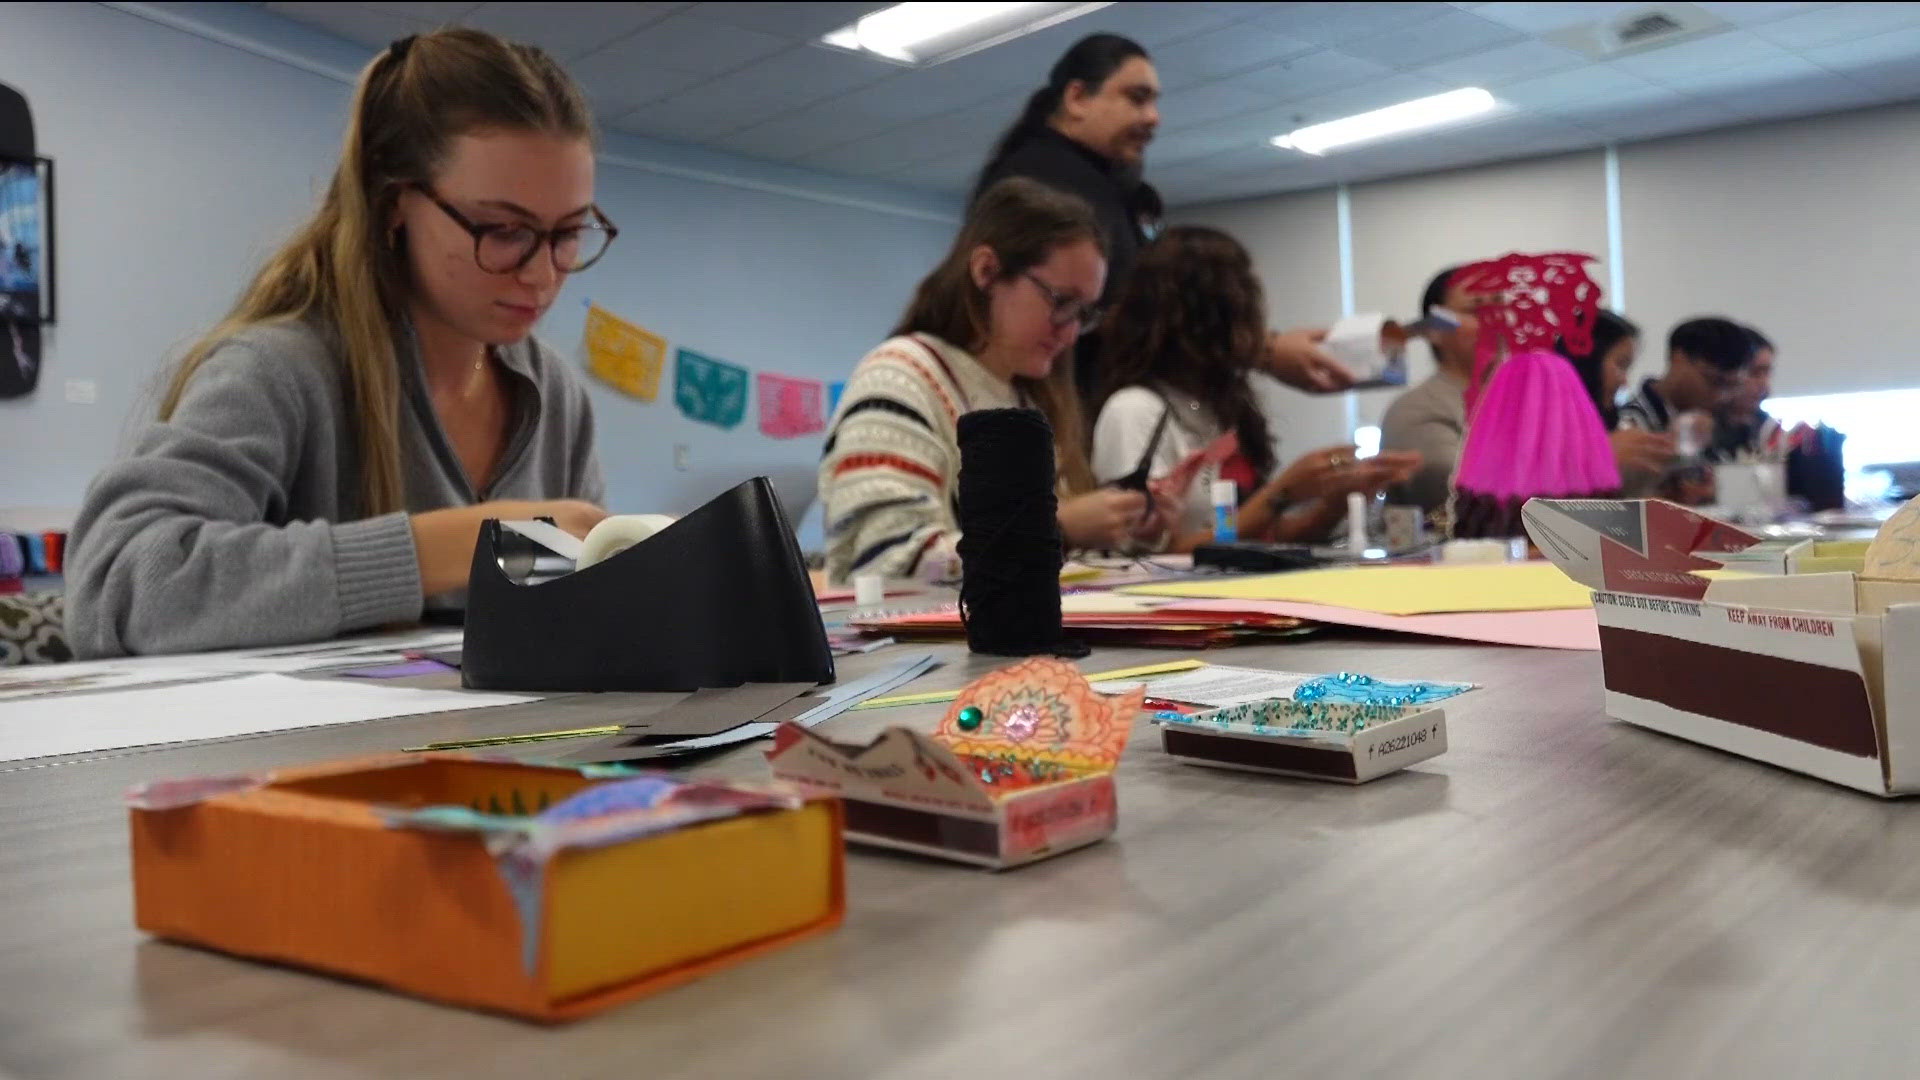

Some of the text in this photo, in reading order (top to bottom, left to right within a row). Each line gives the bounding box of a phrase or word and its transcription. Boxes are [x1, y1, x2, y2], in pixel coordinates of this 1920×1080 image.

[1618, 595, 1636, 607] CLOSE
[1636, 597, 1649, 609] BOX
[1649, 599, 1671, 613] BEFORE
[1672, 601, 1702, 617] STRIKING
[1727, 608, 1835, 637] KEEP AWAY FROM CHILDREN
